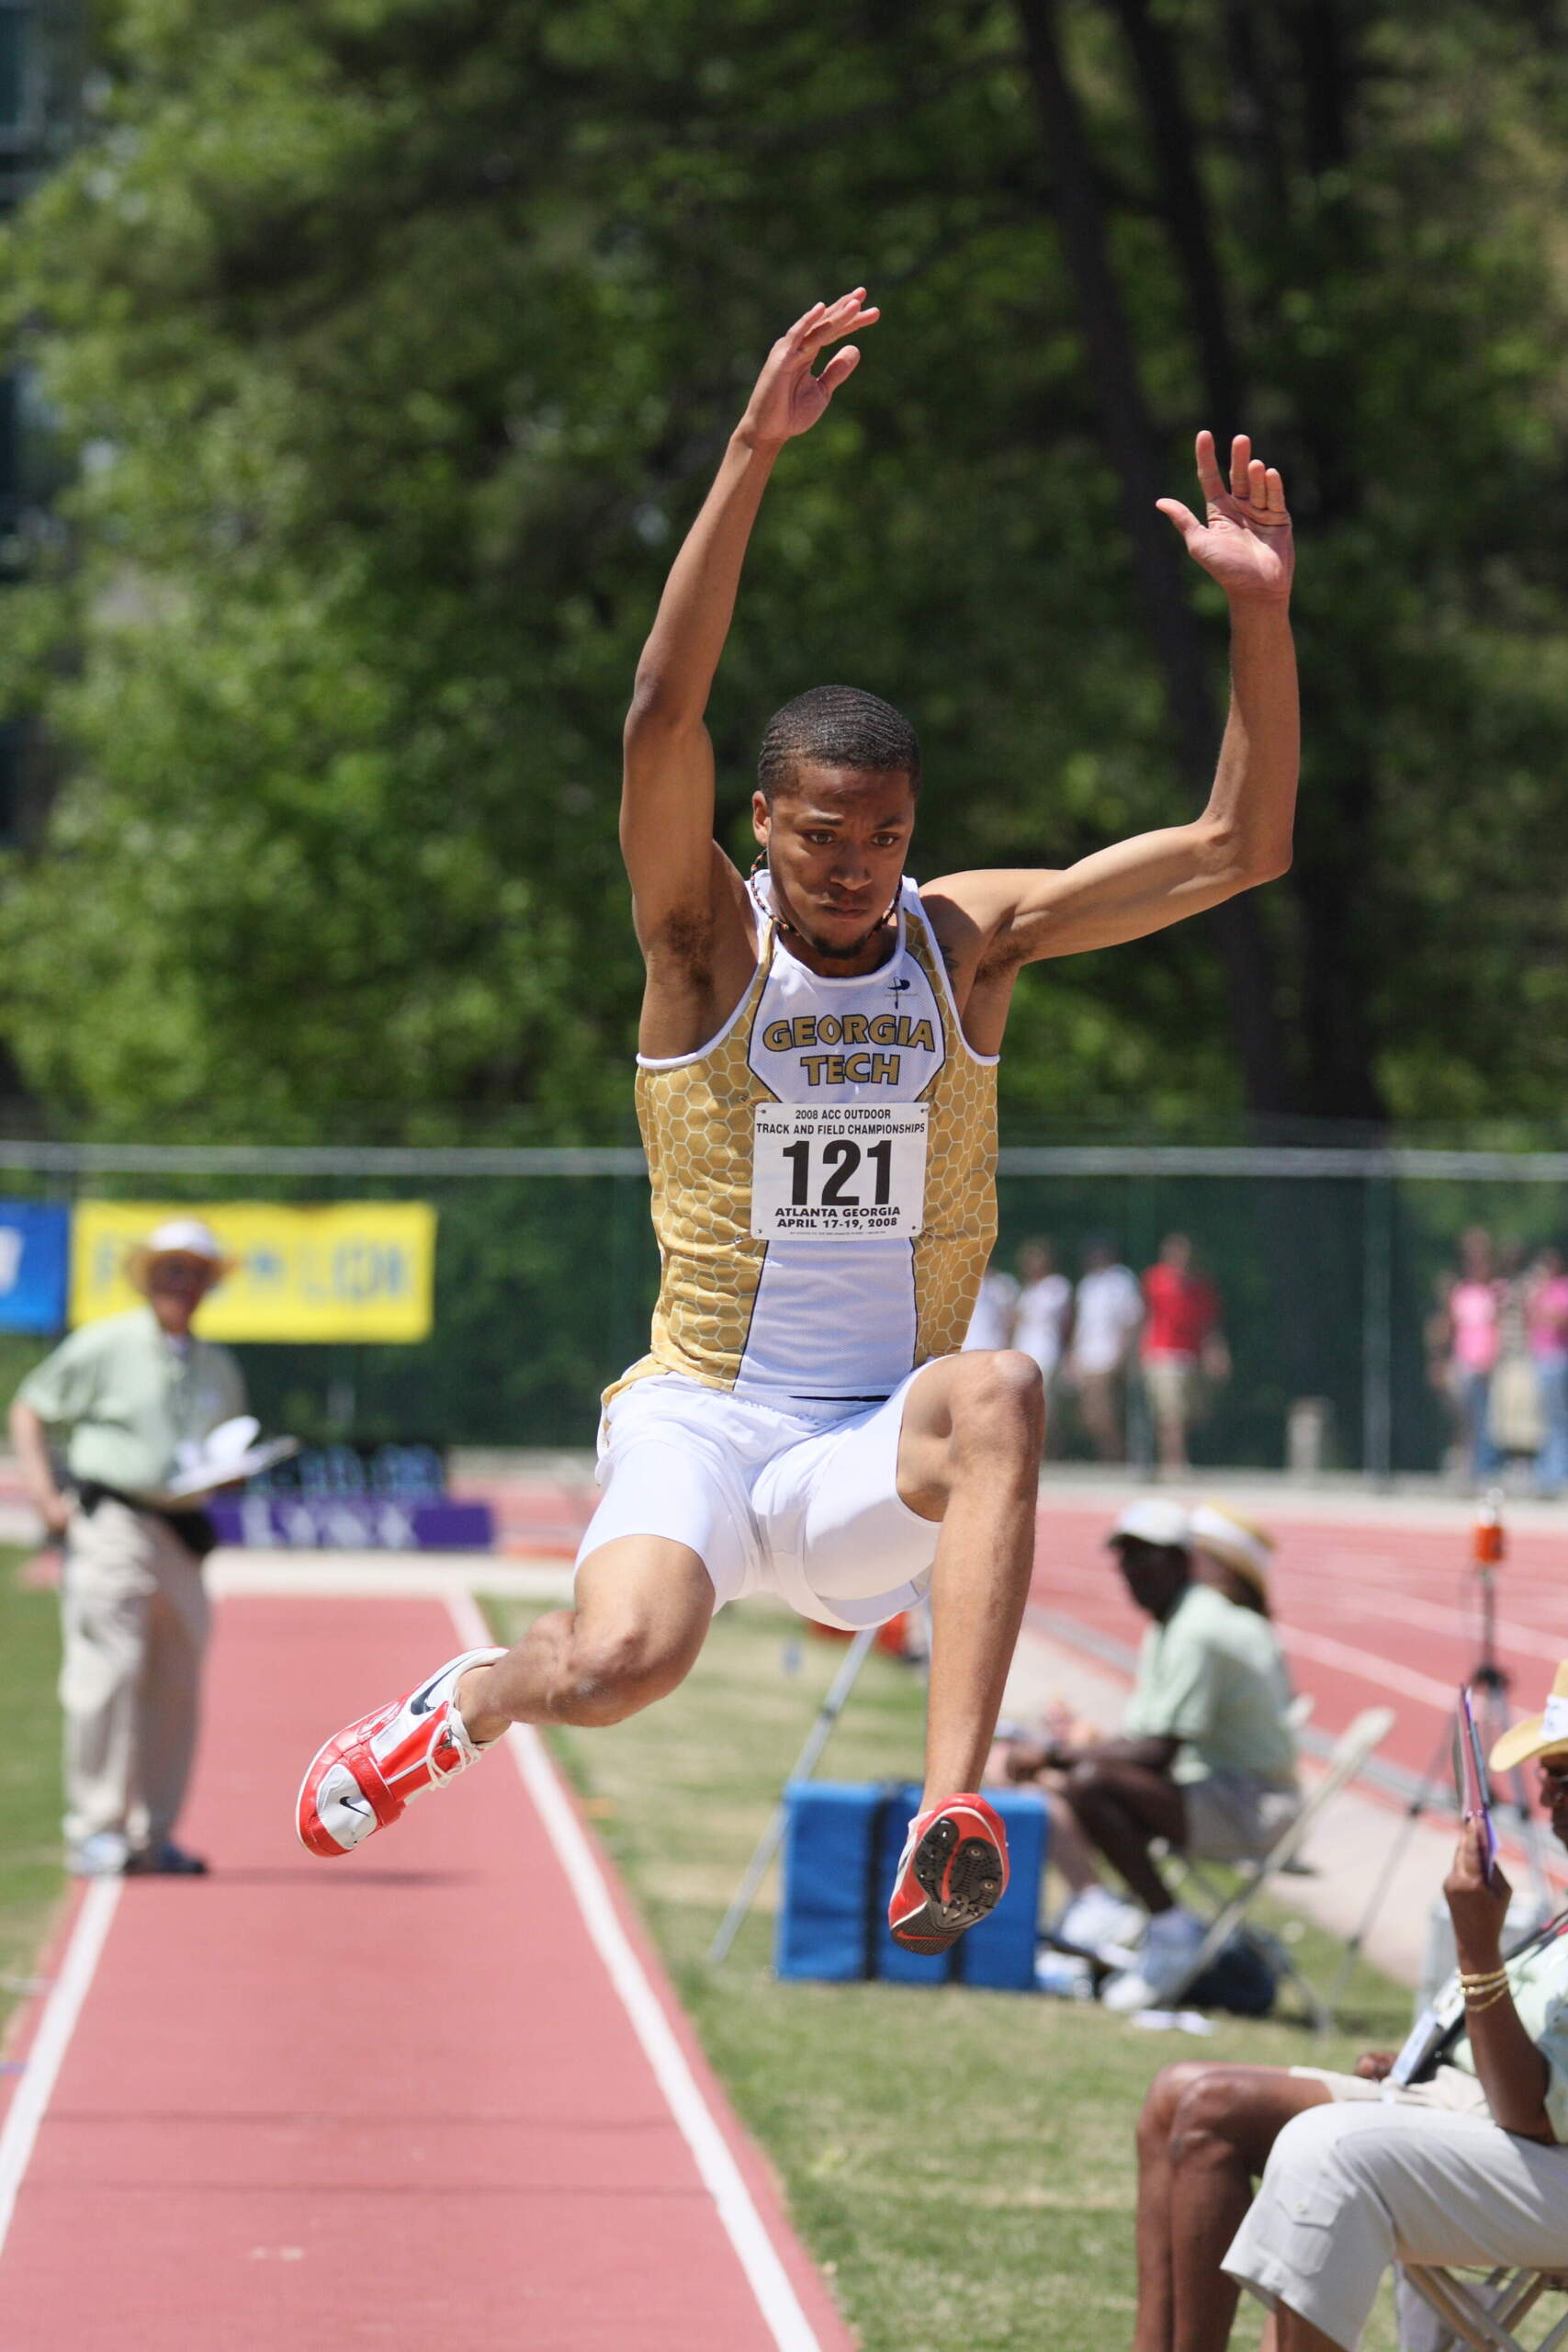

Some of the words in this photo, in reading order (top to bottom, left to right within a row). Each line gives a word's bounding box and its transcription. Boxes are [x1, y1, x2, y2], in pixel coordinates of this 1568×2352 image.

[762, 1013, 936, 1053] GEORGIA
[800, 1052, 901, 1086] TECH
[795, 1110, 818, 1120] 2008
[821, 1110, 841, 1120] ACC
[844, 1109, 891, 1120] OUTDOOR
[756, 1123, 790, 1135] TRACK
[794, 1124, 815, 1135] AND
[818, 1124, 845, 1135] FIELD
[848, 1123, 925, 1135] CHAMPIONSHIPS
[783, 1139, 892, 1205] 121
[774, 1207, 838, 1217] ATLANTA
[842, 1206, 900, 1216] GEORGIA
[776, 1218, 818, 1228] APRIL
[822, 1218, 863, 1229] 17-19,
[868, 1217, 897, 1227] 2008
